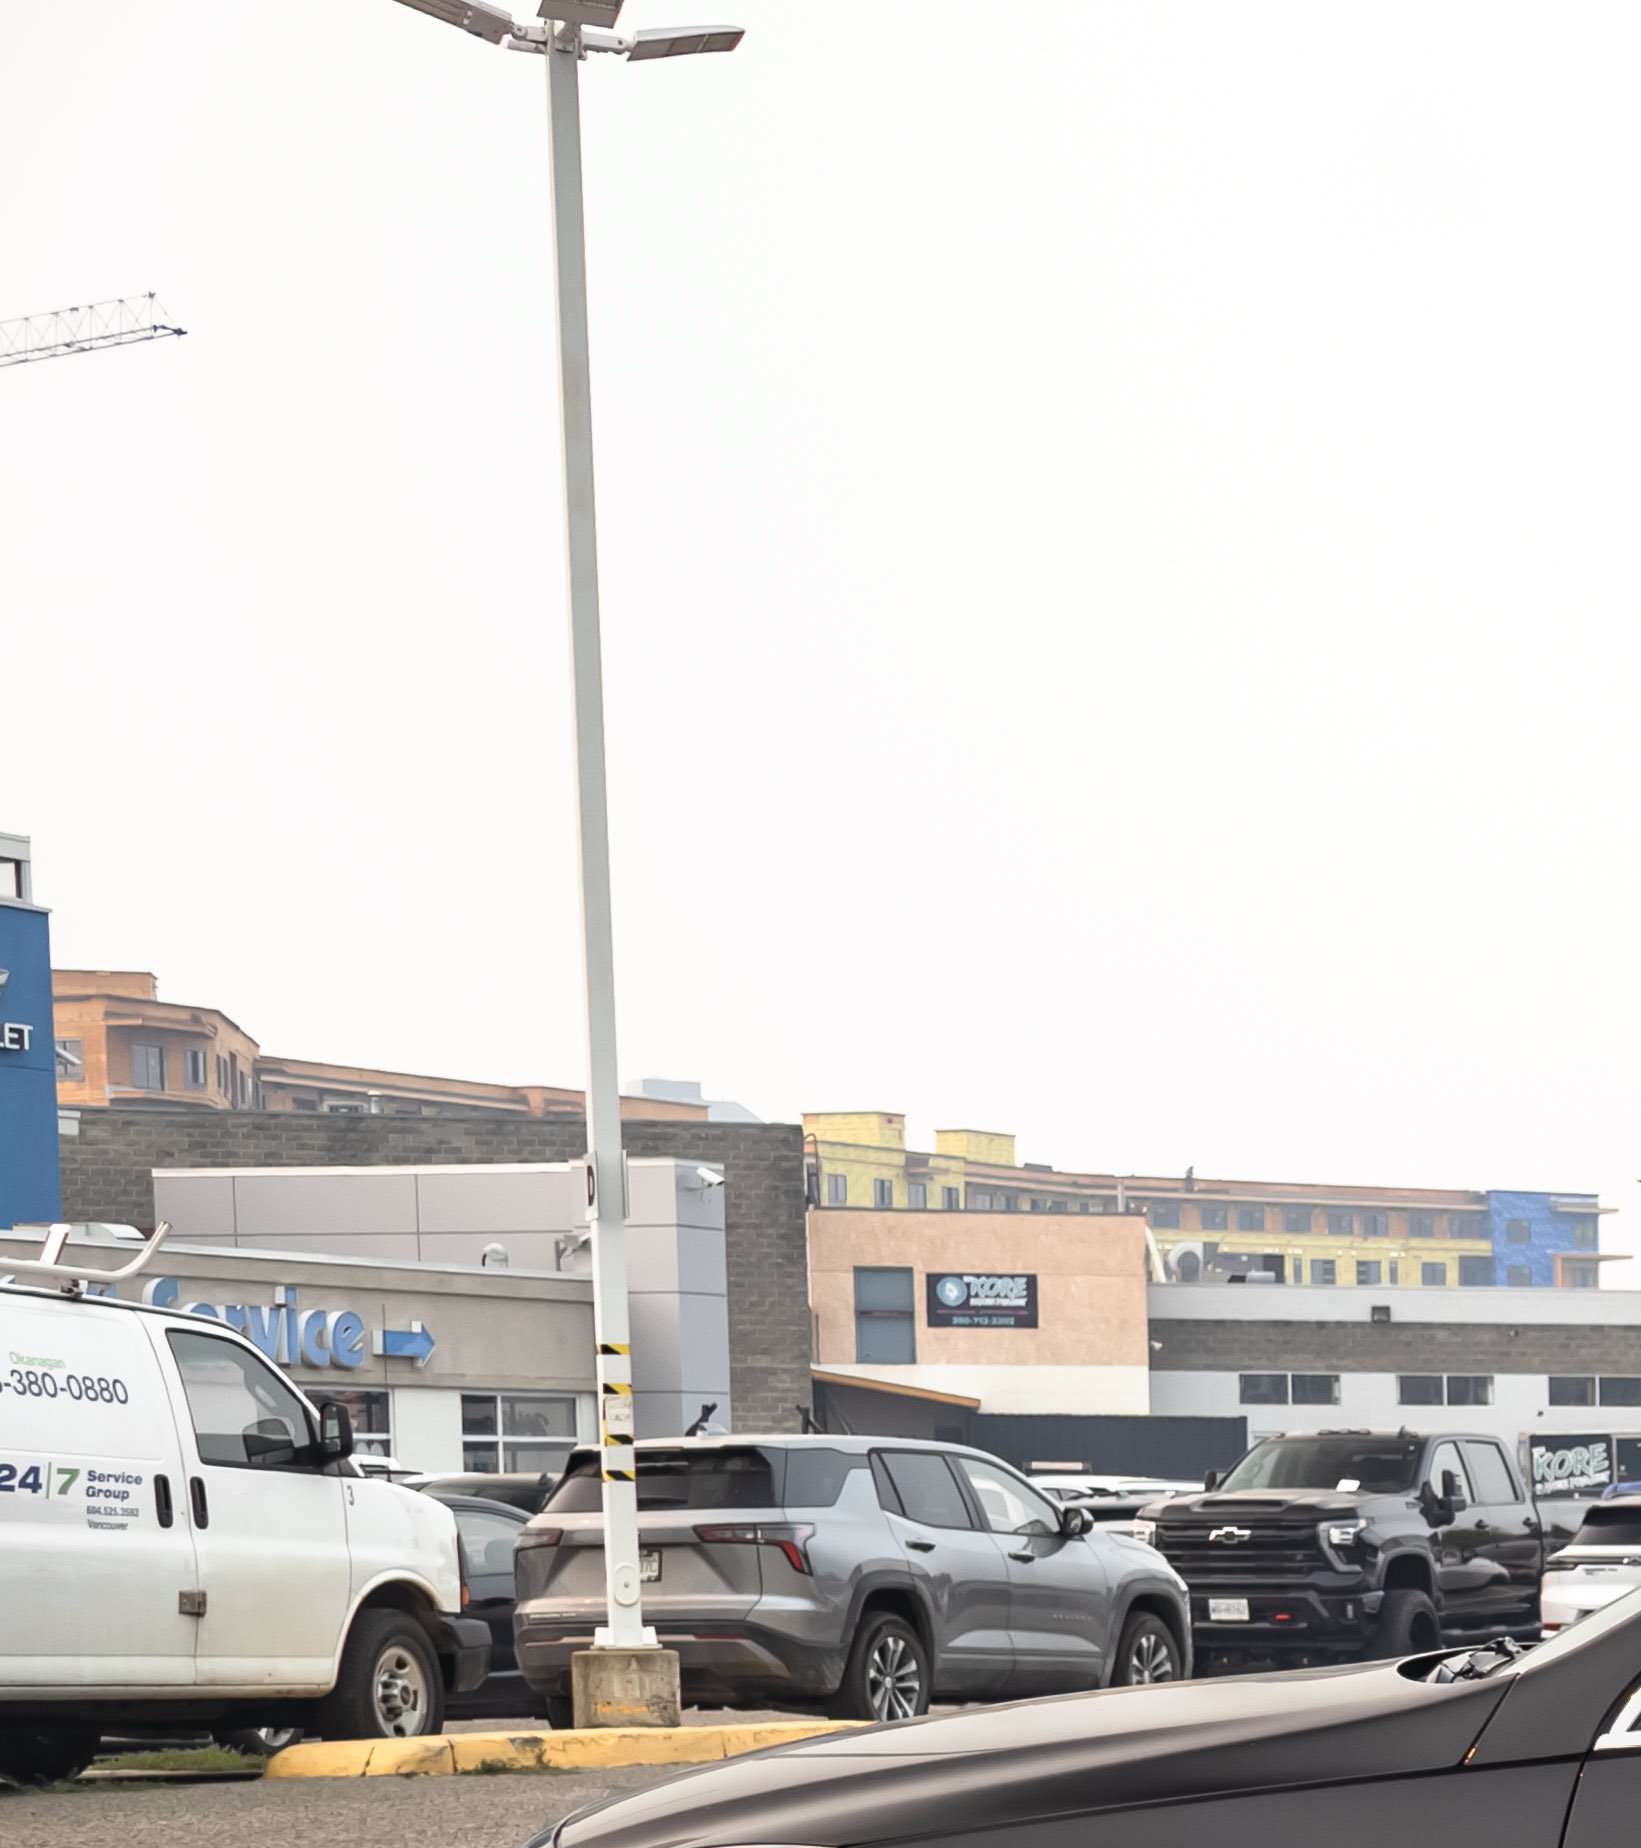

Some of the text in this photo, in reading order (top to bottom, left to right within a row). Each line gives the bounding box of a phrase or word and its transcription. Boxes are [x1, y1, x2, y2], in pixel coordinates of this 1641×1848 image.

[586, 1165, 596, 1207] D
[142, 1276, 365, 1369] vice
[0, 1369, 129, 1405] -380-0880
[87, 1469, 144, 1486] Service
[1531, 1442, 1610, 1484] KORE
[86, 1485, 130, 1502] Group
